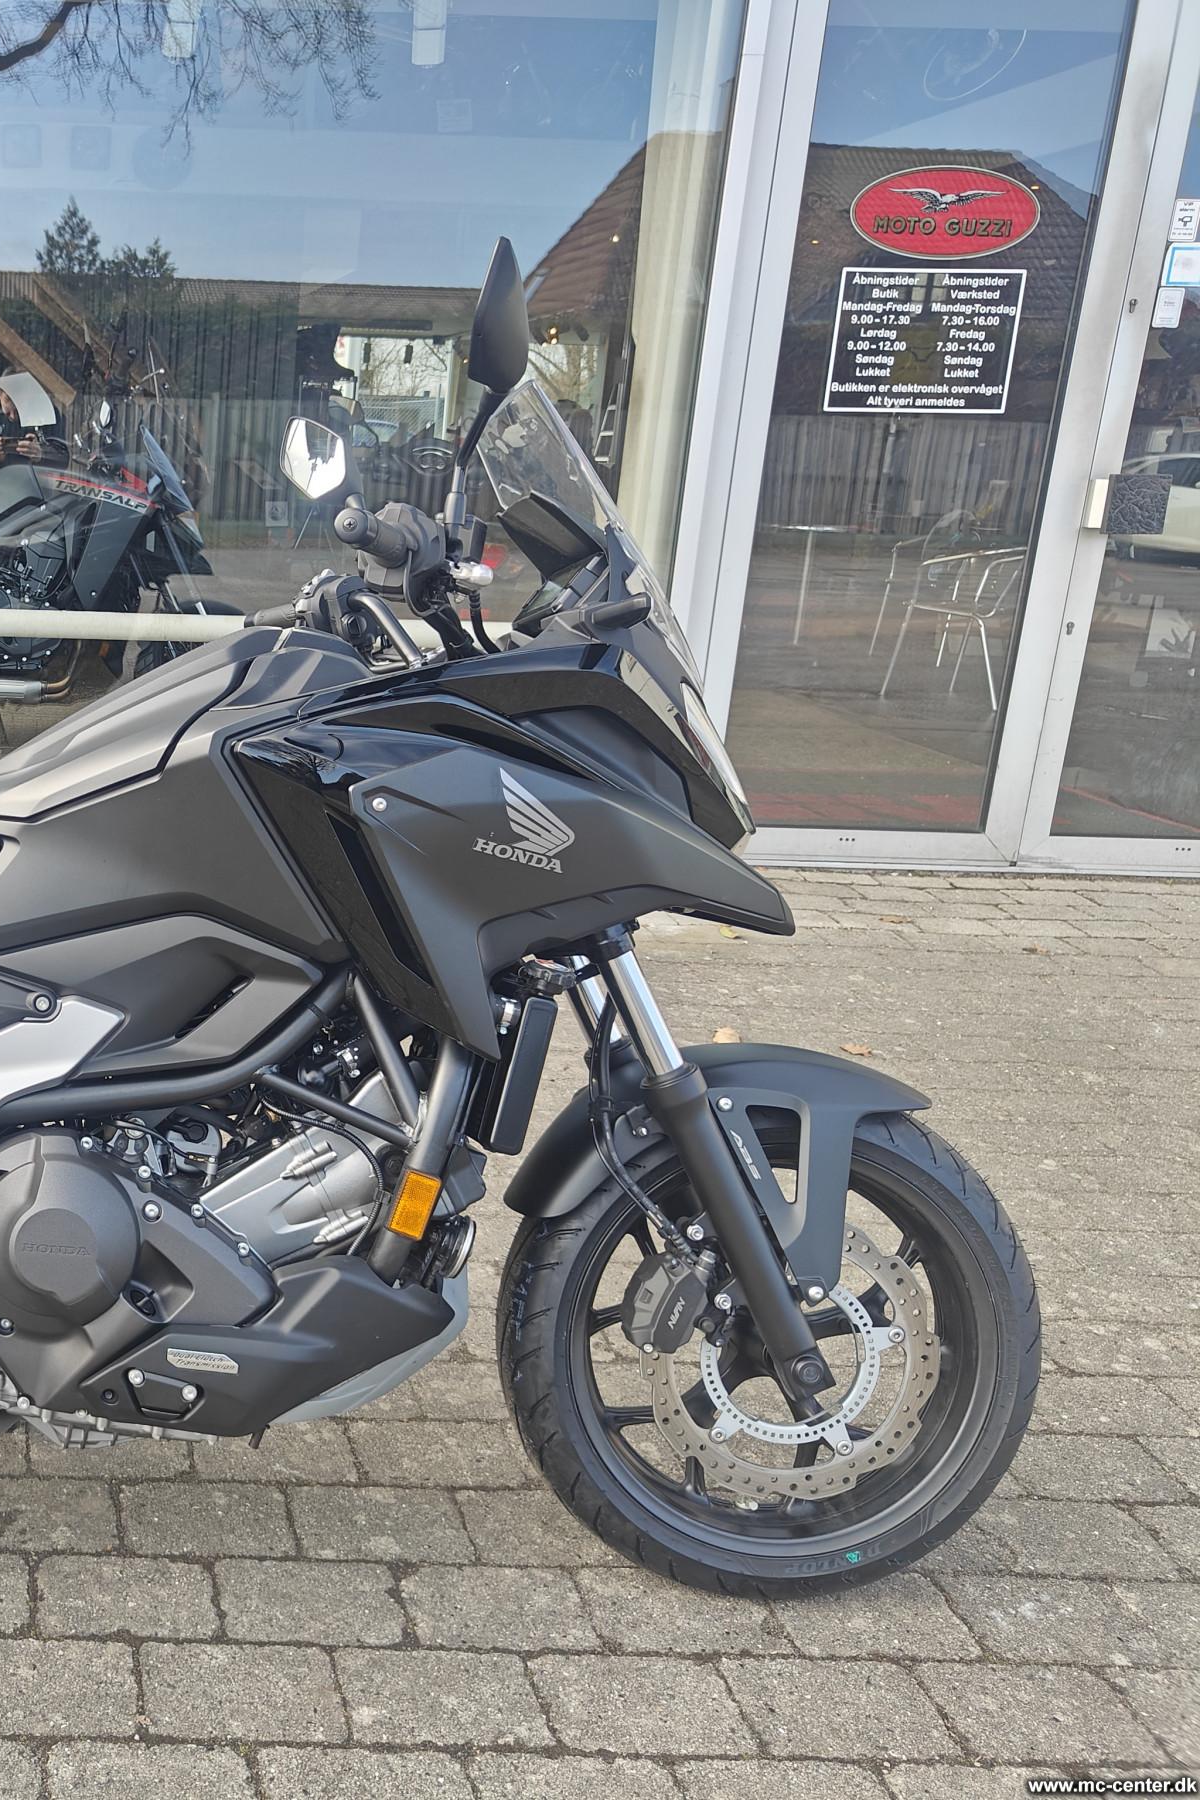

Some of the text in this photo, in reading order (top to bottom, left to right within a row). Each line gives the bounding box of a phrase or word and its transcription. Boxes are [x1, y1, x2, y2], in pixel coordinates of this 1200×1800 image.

[873, 215, 1013, 238] MOTO GUZZI
[852, 272, 920, 286] Åbningstider
[942, 273, 1010, 287] Åbningstider
[872, 288, 900, 299] Butik
[950, 289, 1001, 300] Værksted
[842, 301, 923, 315] Mandag-Fredag
[931, 302, 1017, 316] Mandag-Torsdag
[860, 327, 897, 340] Lørdag
[949, 328, 986, 341] Fredag
[855, 354, 895, 366] Søndag
[944, 354, 984, 367] Søndag
[855, 367, 891, 377] Lukket
[944, 368, 979, 378] Lukket
[831, 382, 1003, 396] Butikken er elektronisk overvåget
[866, 396, 966, 409] Alt tyveri anmeldes
[54, 479, 149, 510] TRANSALP
[472, 837, 563, 873] HONDA
[730, 1129, 762, 1180] ABS
[23, 1242, 91, 1256] HONDA
[783, 1543, 882, 1574] DNLOP
